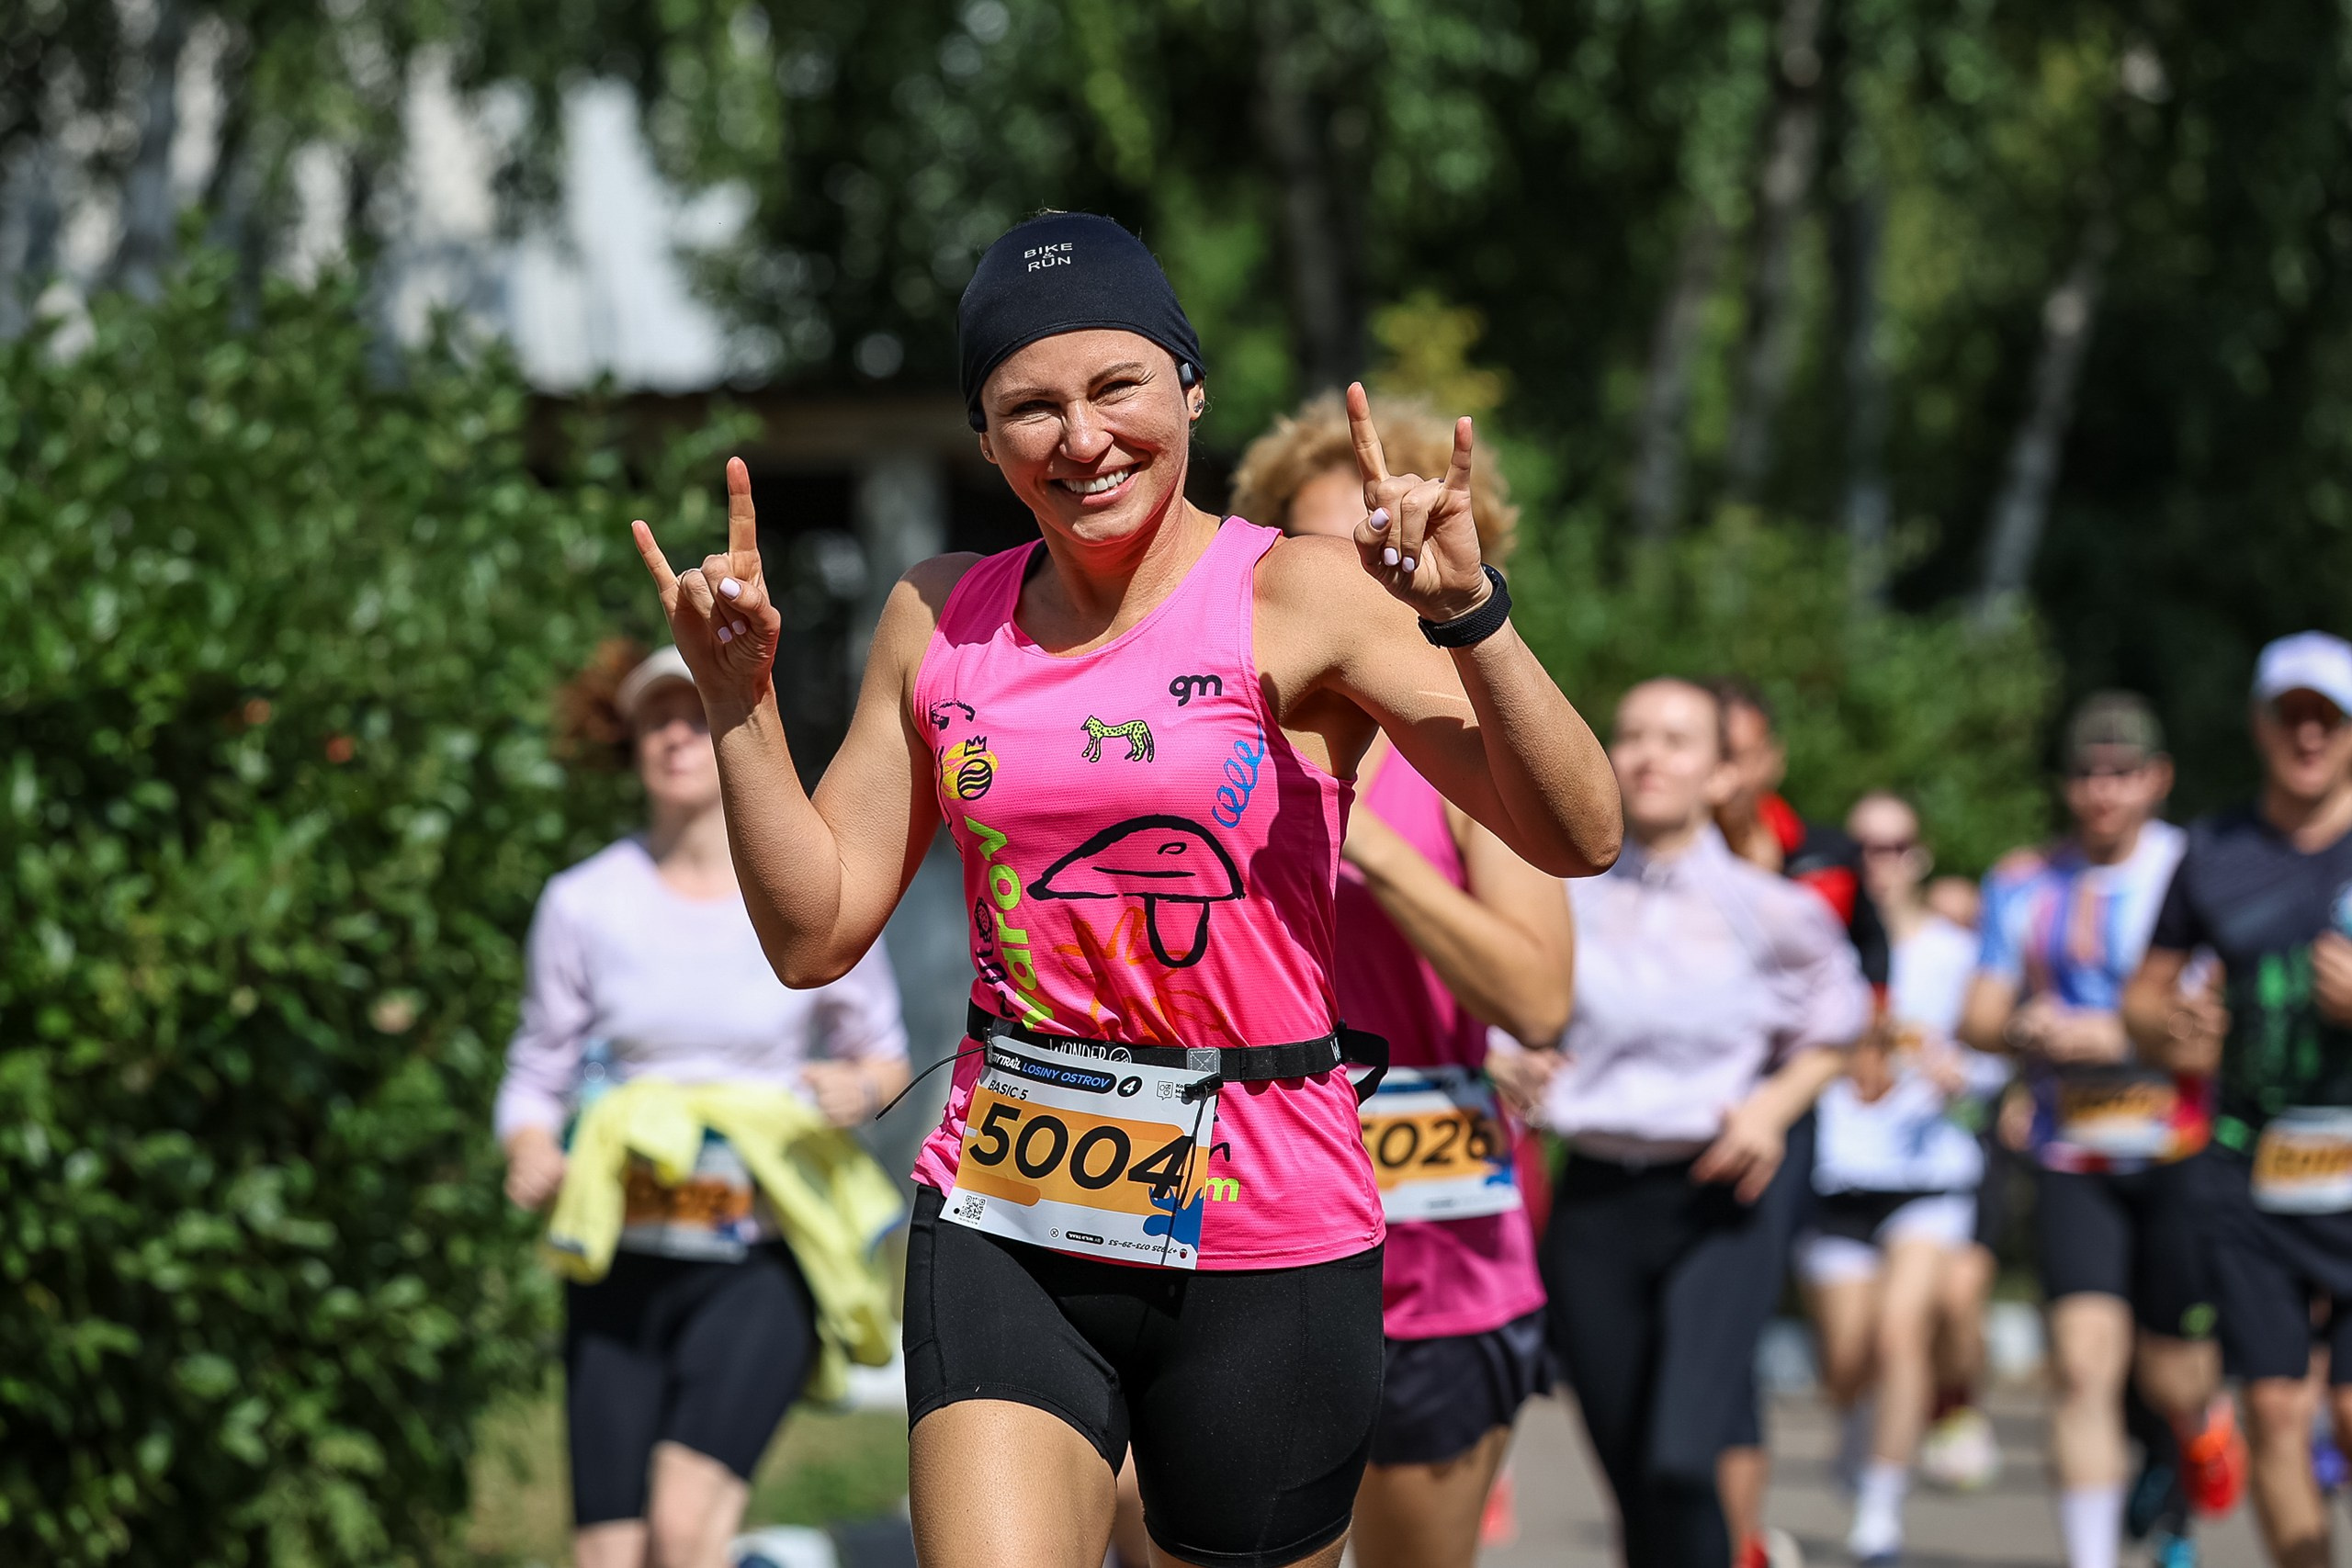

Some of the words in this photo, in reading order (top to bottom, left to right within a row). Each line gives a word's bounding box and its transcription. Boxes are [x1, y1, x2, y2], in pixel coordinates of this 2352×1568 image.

[1024, 243, 1073, 258] BIKE
[1028, 256, 1071, 272] RUN
[1169, 674, 1223, 707] gm
[988, 1080, 1017, 1098] BASIC
[1019, 1089, 1029, 1100] 5
[1022, 1065, 1060, 1079] LOSINY
[1060, 1072, 1111, 1089] OSTROV
[1123, 1080, 1136, 1093] 4
[967, 1102, 1194, 1200] 5004
[1362, 1114, 1492, 1168] 026
